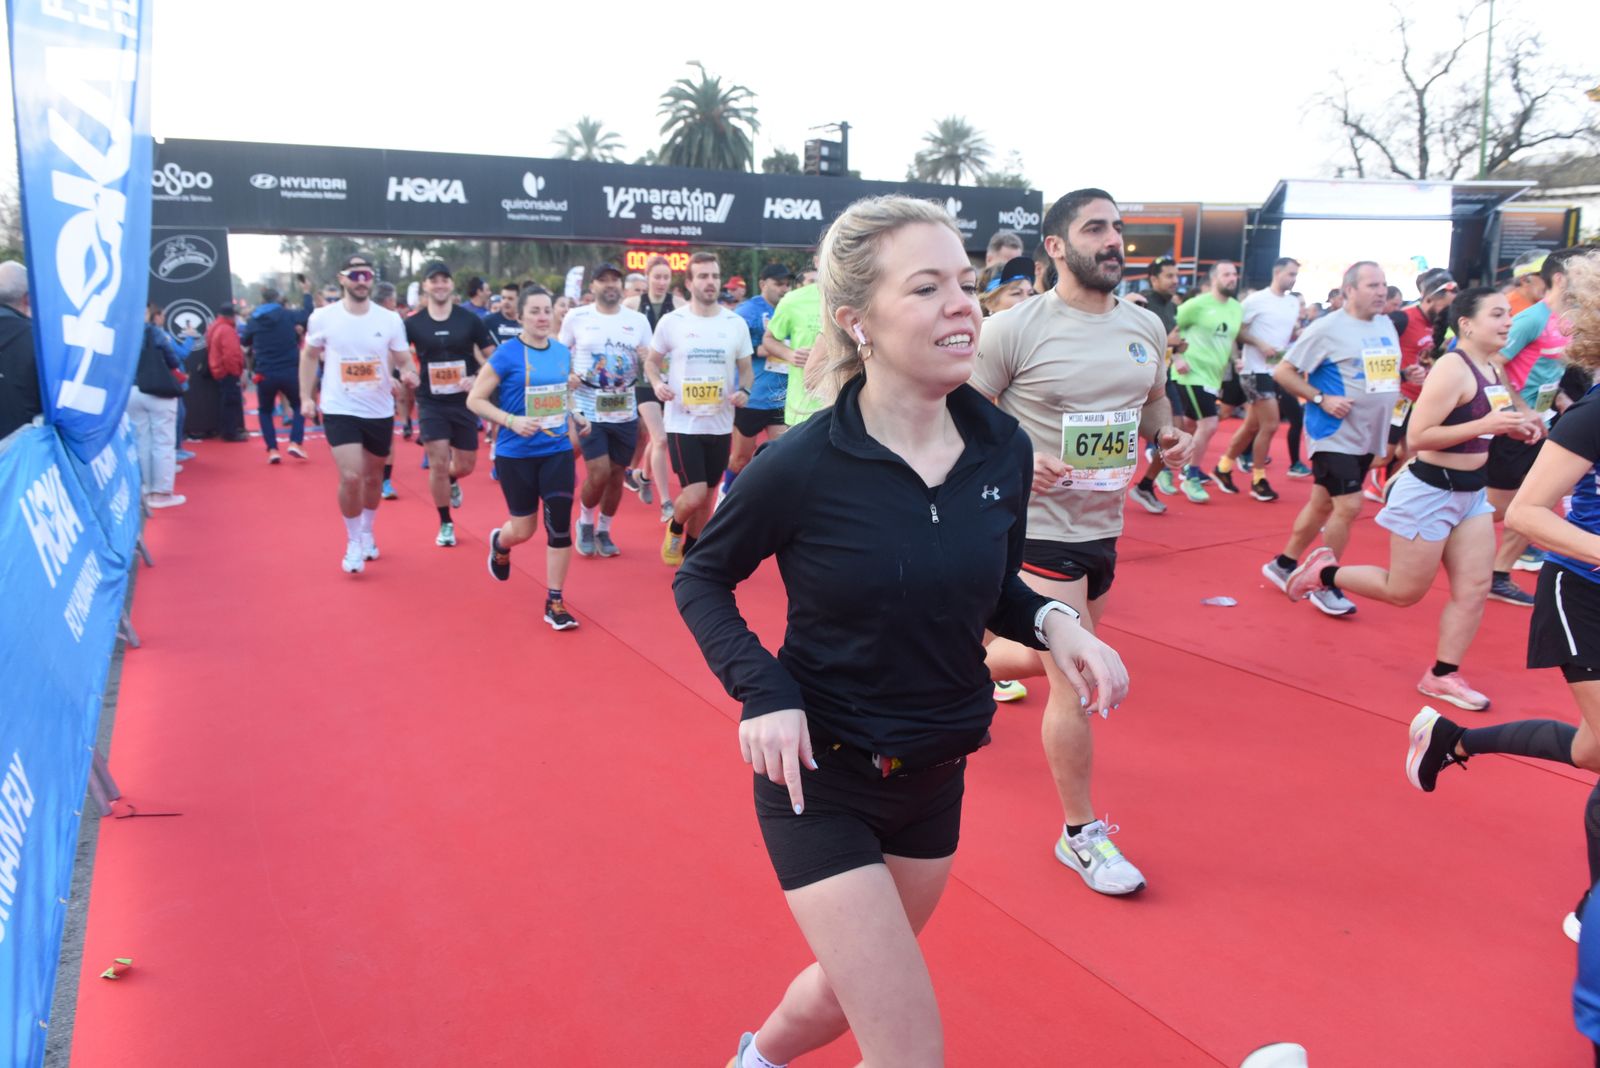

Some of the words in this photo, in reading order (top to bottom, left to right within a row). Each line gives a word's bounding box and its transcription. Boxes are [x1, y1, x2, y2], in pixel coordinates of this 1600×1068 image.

[280, 175, 347, 190] HYUNDAI
[387, 176, 468, 204] HOKA
[628, 187, 716, 207] maratón
[763, 197, 823, 221] HOKA
[46, 46, 137, 415] HOKA
[641, 224, 652, 234] 28
[654, 225, 679, 235] enero
[680, 226, 702, 235] 2024
[686, 385, 718, 398] 10377
[1076, 431, 1125, 457] 6745
[19, 463, 84, 589] HOKA
